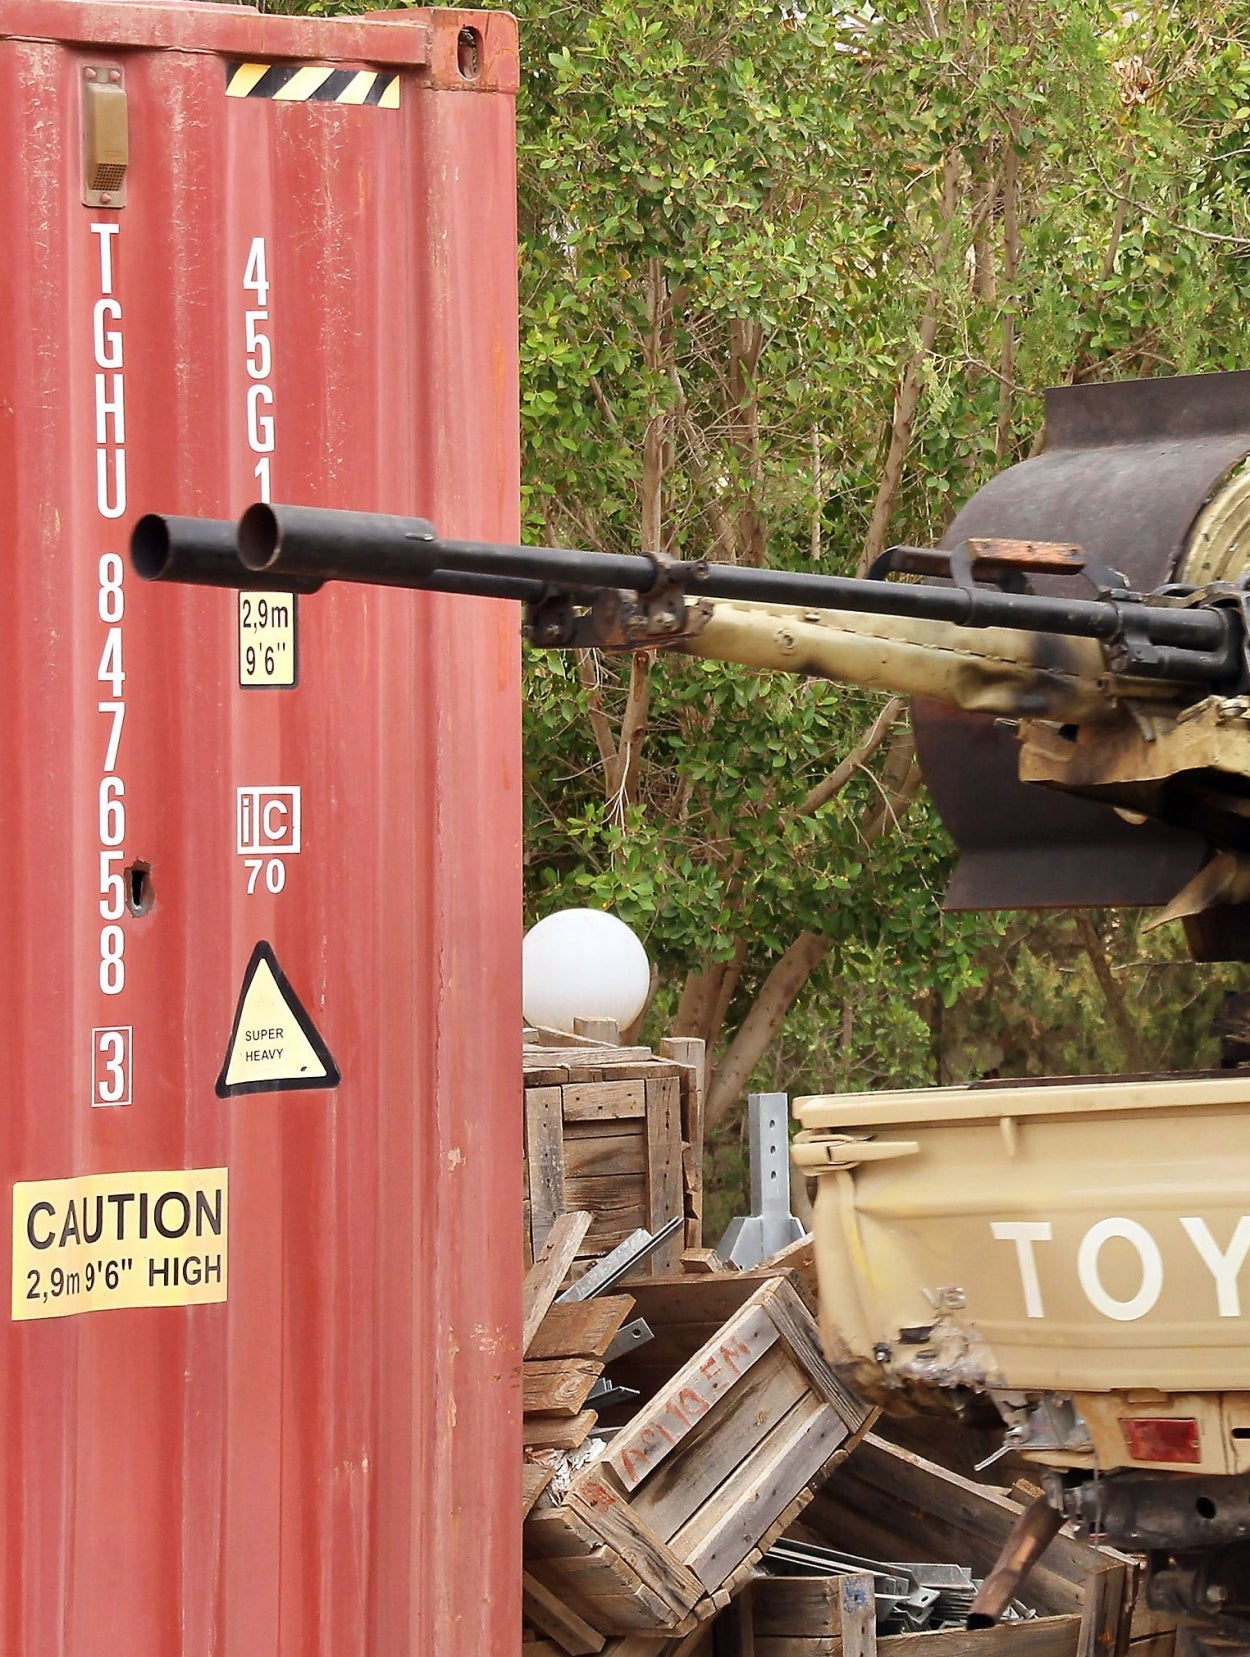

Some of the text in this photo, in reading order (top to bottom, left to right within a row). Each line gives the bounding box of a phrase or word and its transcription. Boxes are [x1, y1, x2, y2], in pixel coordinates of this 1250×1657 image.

[243, 237, 276, 504] 45G1
[242, 599, 289, 634] 2,9m
[90, 222, 128, 1103] TGHU 847658 3
[243, 858, 287, 895] 70
[245, 1027, 284, 1042] SUPER
[245, 1048, 284, 1062] HEAVY
[26, 1189, 222, 1250] CAUTION
[148, 1254, 222, 1287] HIGH
